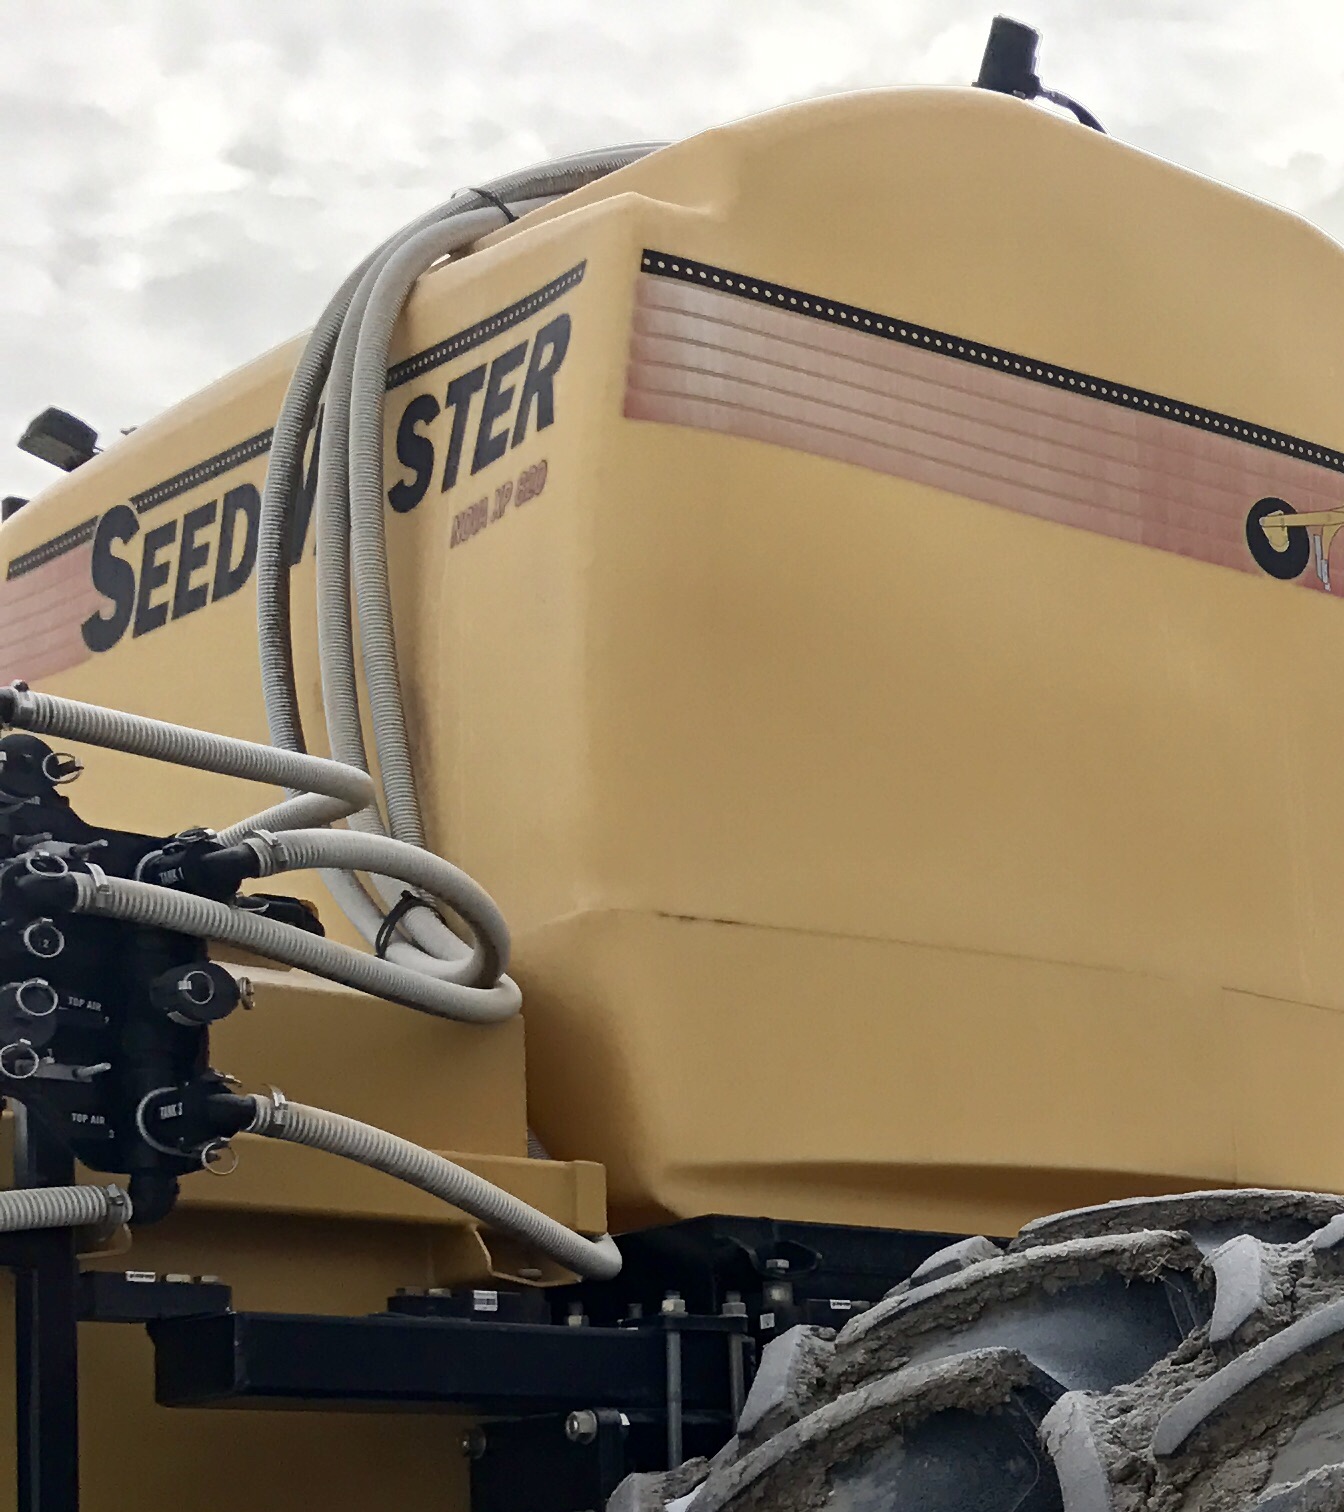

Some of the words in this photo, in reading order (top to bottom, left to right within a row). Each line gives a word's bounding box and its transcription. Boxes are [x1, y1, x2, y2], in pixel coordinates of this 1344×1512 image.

[80, 314, 572, 653] SEEDSTER
[68, 996, 86, 1008] TOP
[86, 1000, 102, 1012] AIR
[71, 1113, 88, 1124] TOP
[90, 1115, 106, 1125] AIR
